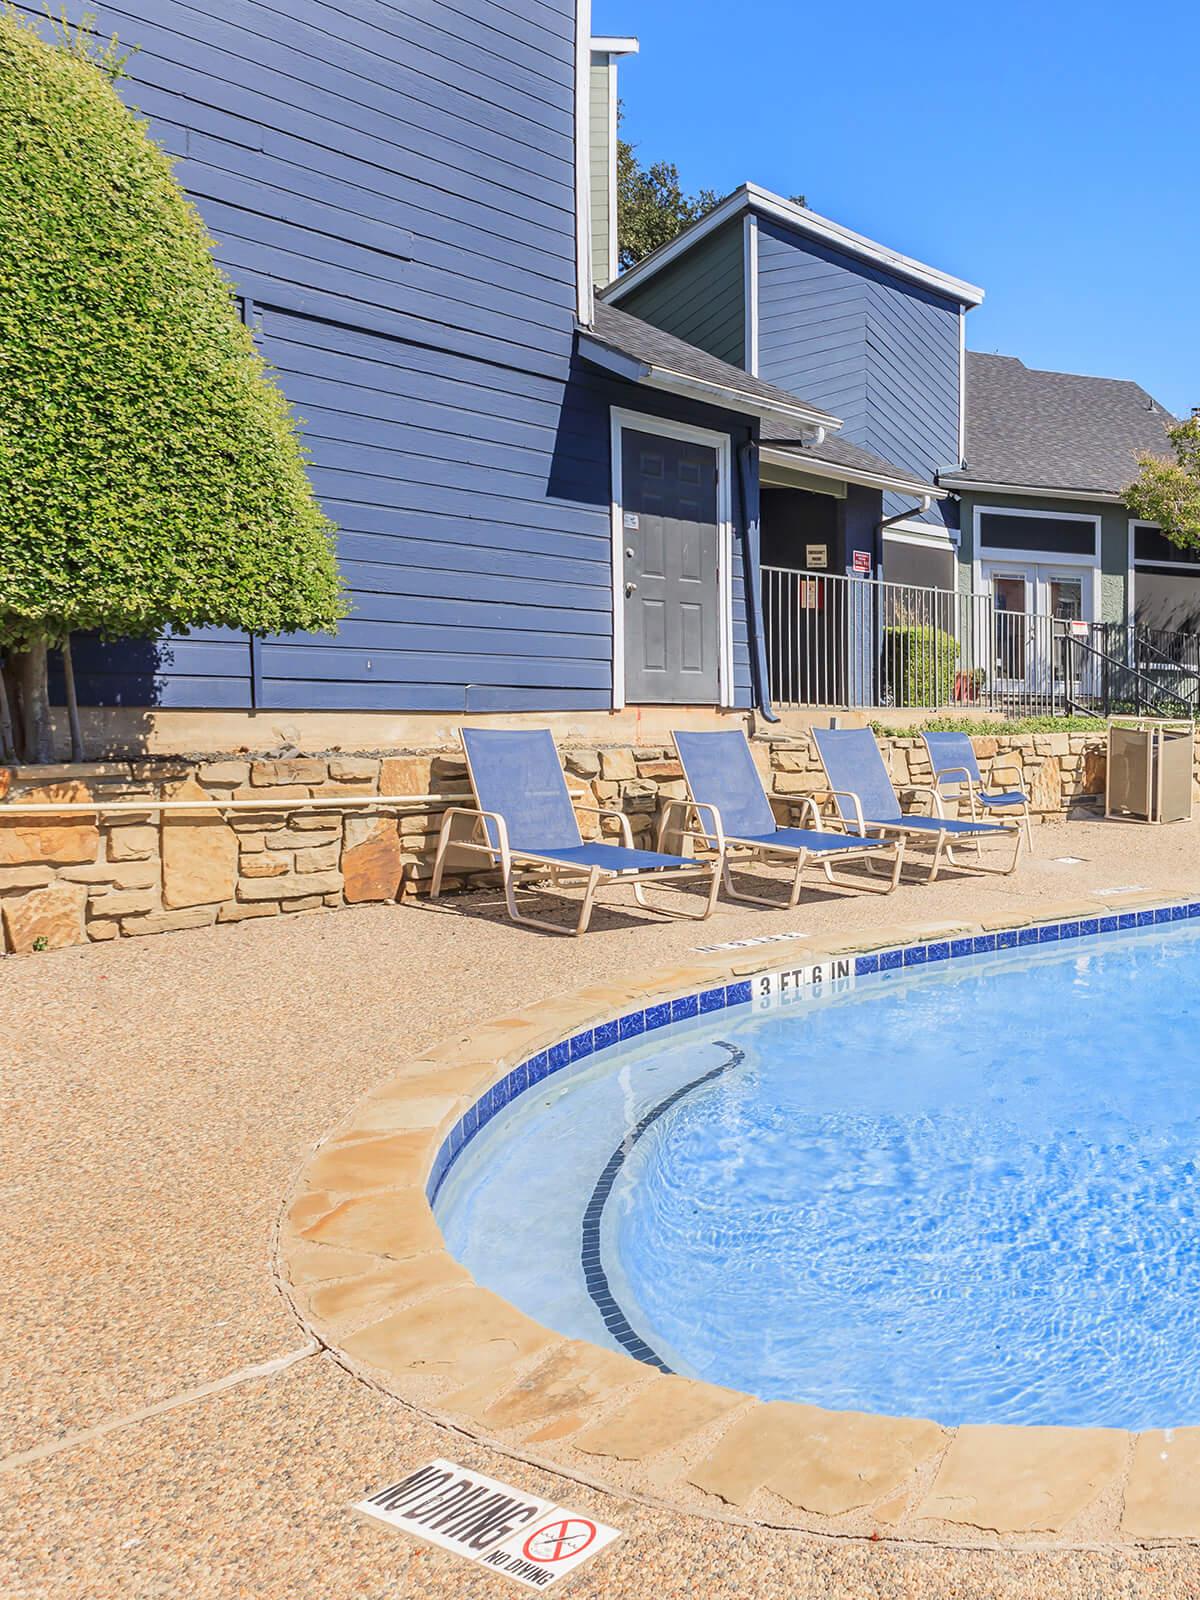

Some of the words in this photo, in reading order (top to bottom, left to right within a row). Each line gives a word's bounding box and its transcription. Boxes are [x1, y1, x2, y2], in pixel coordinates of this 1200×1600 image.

[760, 977, 771, 996] 3
[780, 969, 802, 991] FT
[812, 966, 822, 984] 6
[831, 959, 849, 980] IN
[367, 1465, 454, 1512] NO
[401, 1480, 539, 1551] DIVING
[484, 1550, 507, 1567] NO
[504, 1558, 555, 1587] DIVING
